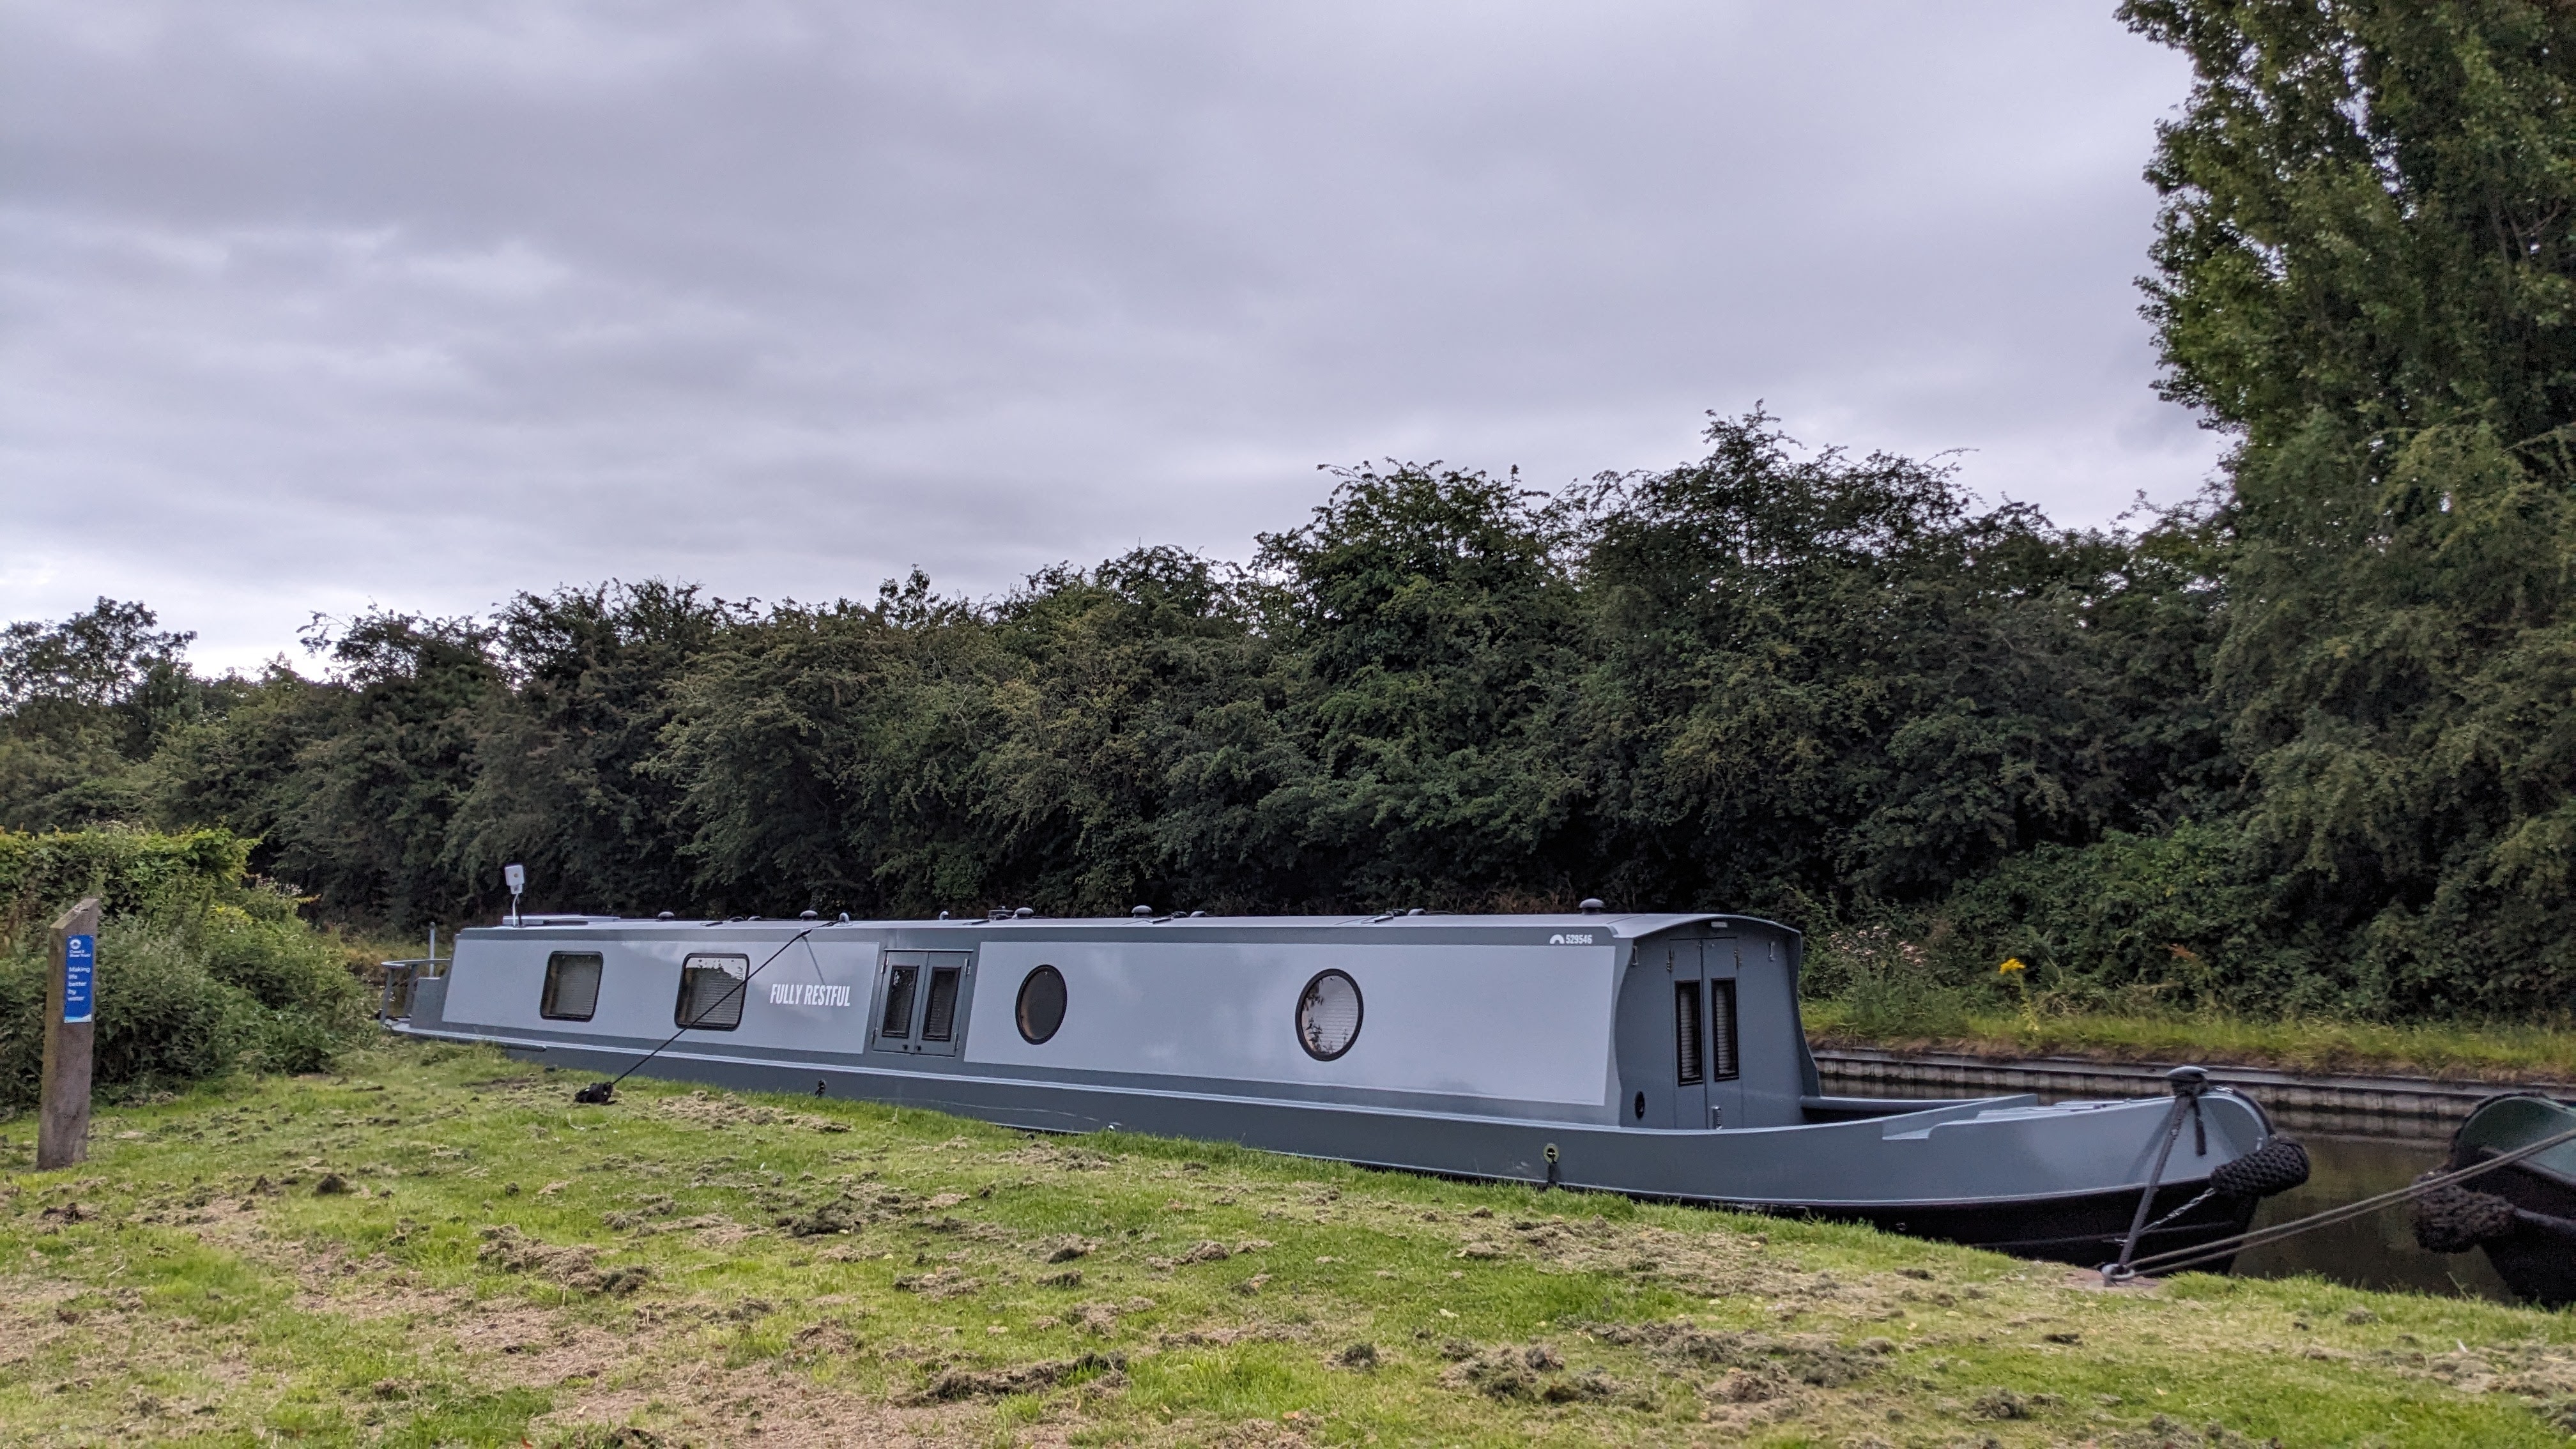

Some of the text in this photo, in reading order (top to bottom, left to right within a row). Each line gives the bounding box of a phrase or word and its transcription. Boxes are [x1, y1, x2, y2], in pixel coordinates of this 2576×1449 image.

[1565, 934, 1593, 944] 529546
[770, 984, 850, 1006] FULLY RESTFUL
